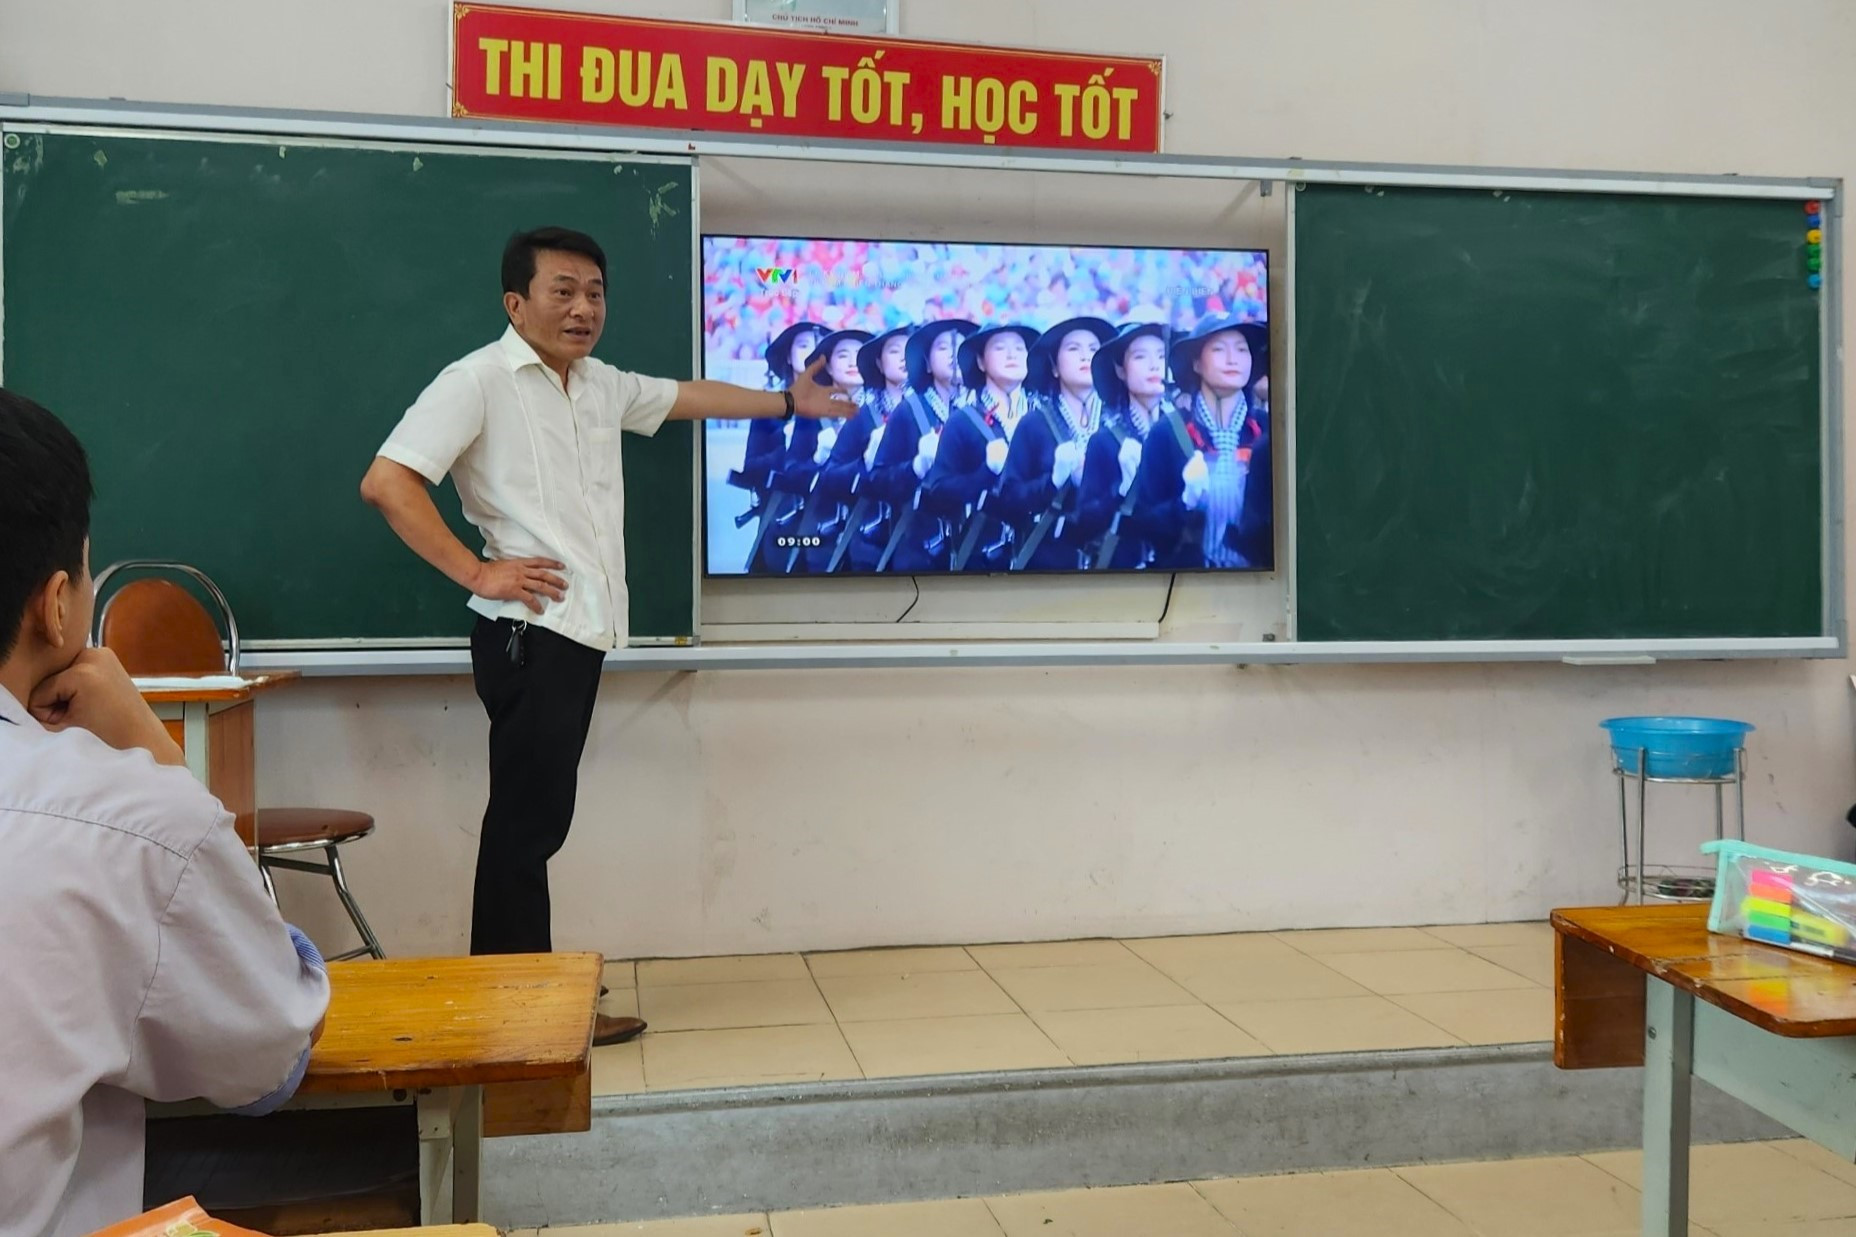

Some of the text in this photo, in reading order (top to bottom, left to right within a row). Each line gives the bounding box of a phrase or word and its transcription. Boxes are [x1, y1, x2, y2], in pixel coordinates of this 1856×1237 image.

[772, 13, 788, 21] CHỦ
[791, 14, 808, 23] TỊCH
[810, 15, 821, 23] HỒ
[823, 16, 836, 25] CHÍ
[838, 19, 858, 27] MINH
[478, 38, 1139, 144] THI ĐUA DẠY TỐT, HỌC TỐT
[756, 268, 798, 284] VTV1
[777, 536, 821, 547] 09:00
